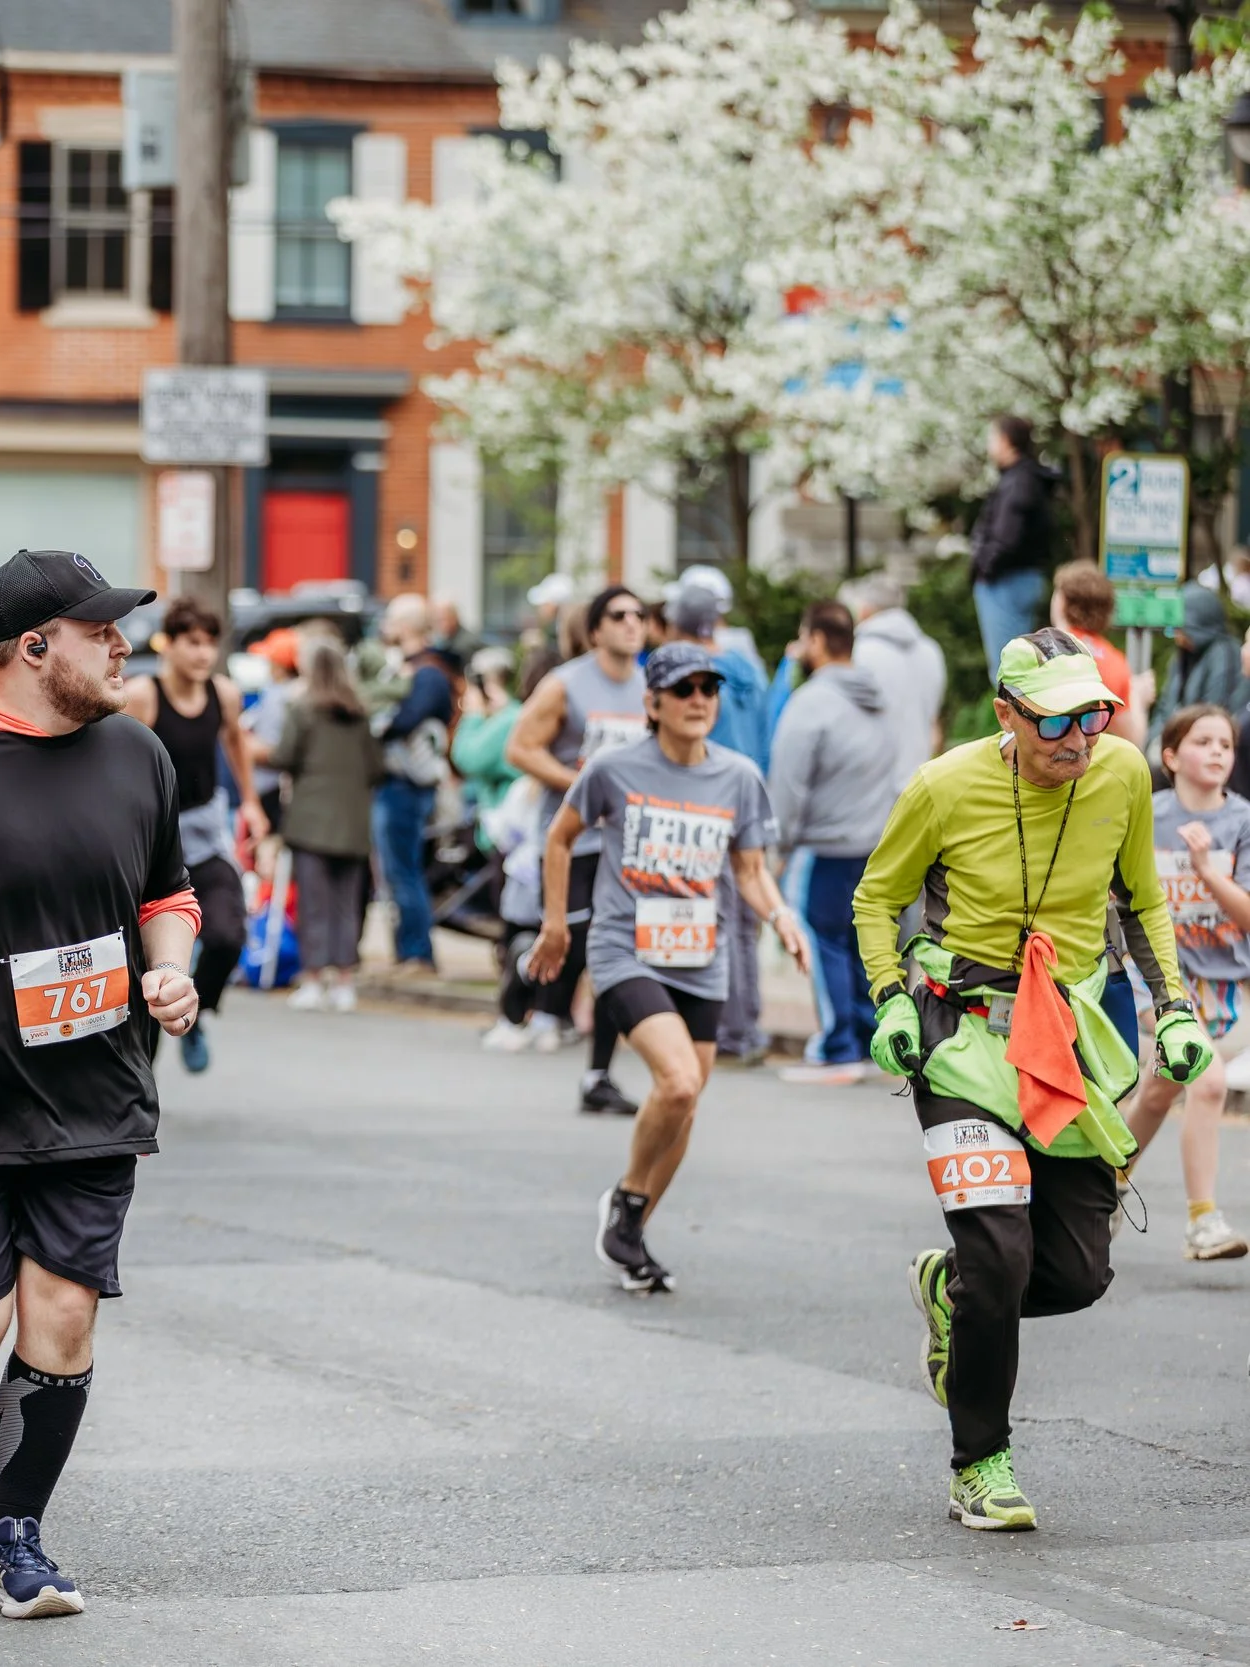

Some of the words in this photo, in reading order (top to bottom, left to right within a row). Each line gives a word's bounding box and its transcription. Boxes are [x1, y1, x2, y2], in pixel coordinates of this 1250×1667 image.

[1109, 456, 1137, 499] 2
[43, 976, 108, 1020] 767
[30, 1031, 49, 1039] ywca
[941, 1154, 1012, 1187] 402
